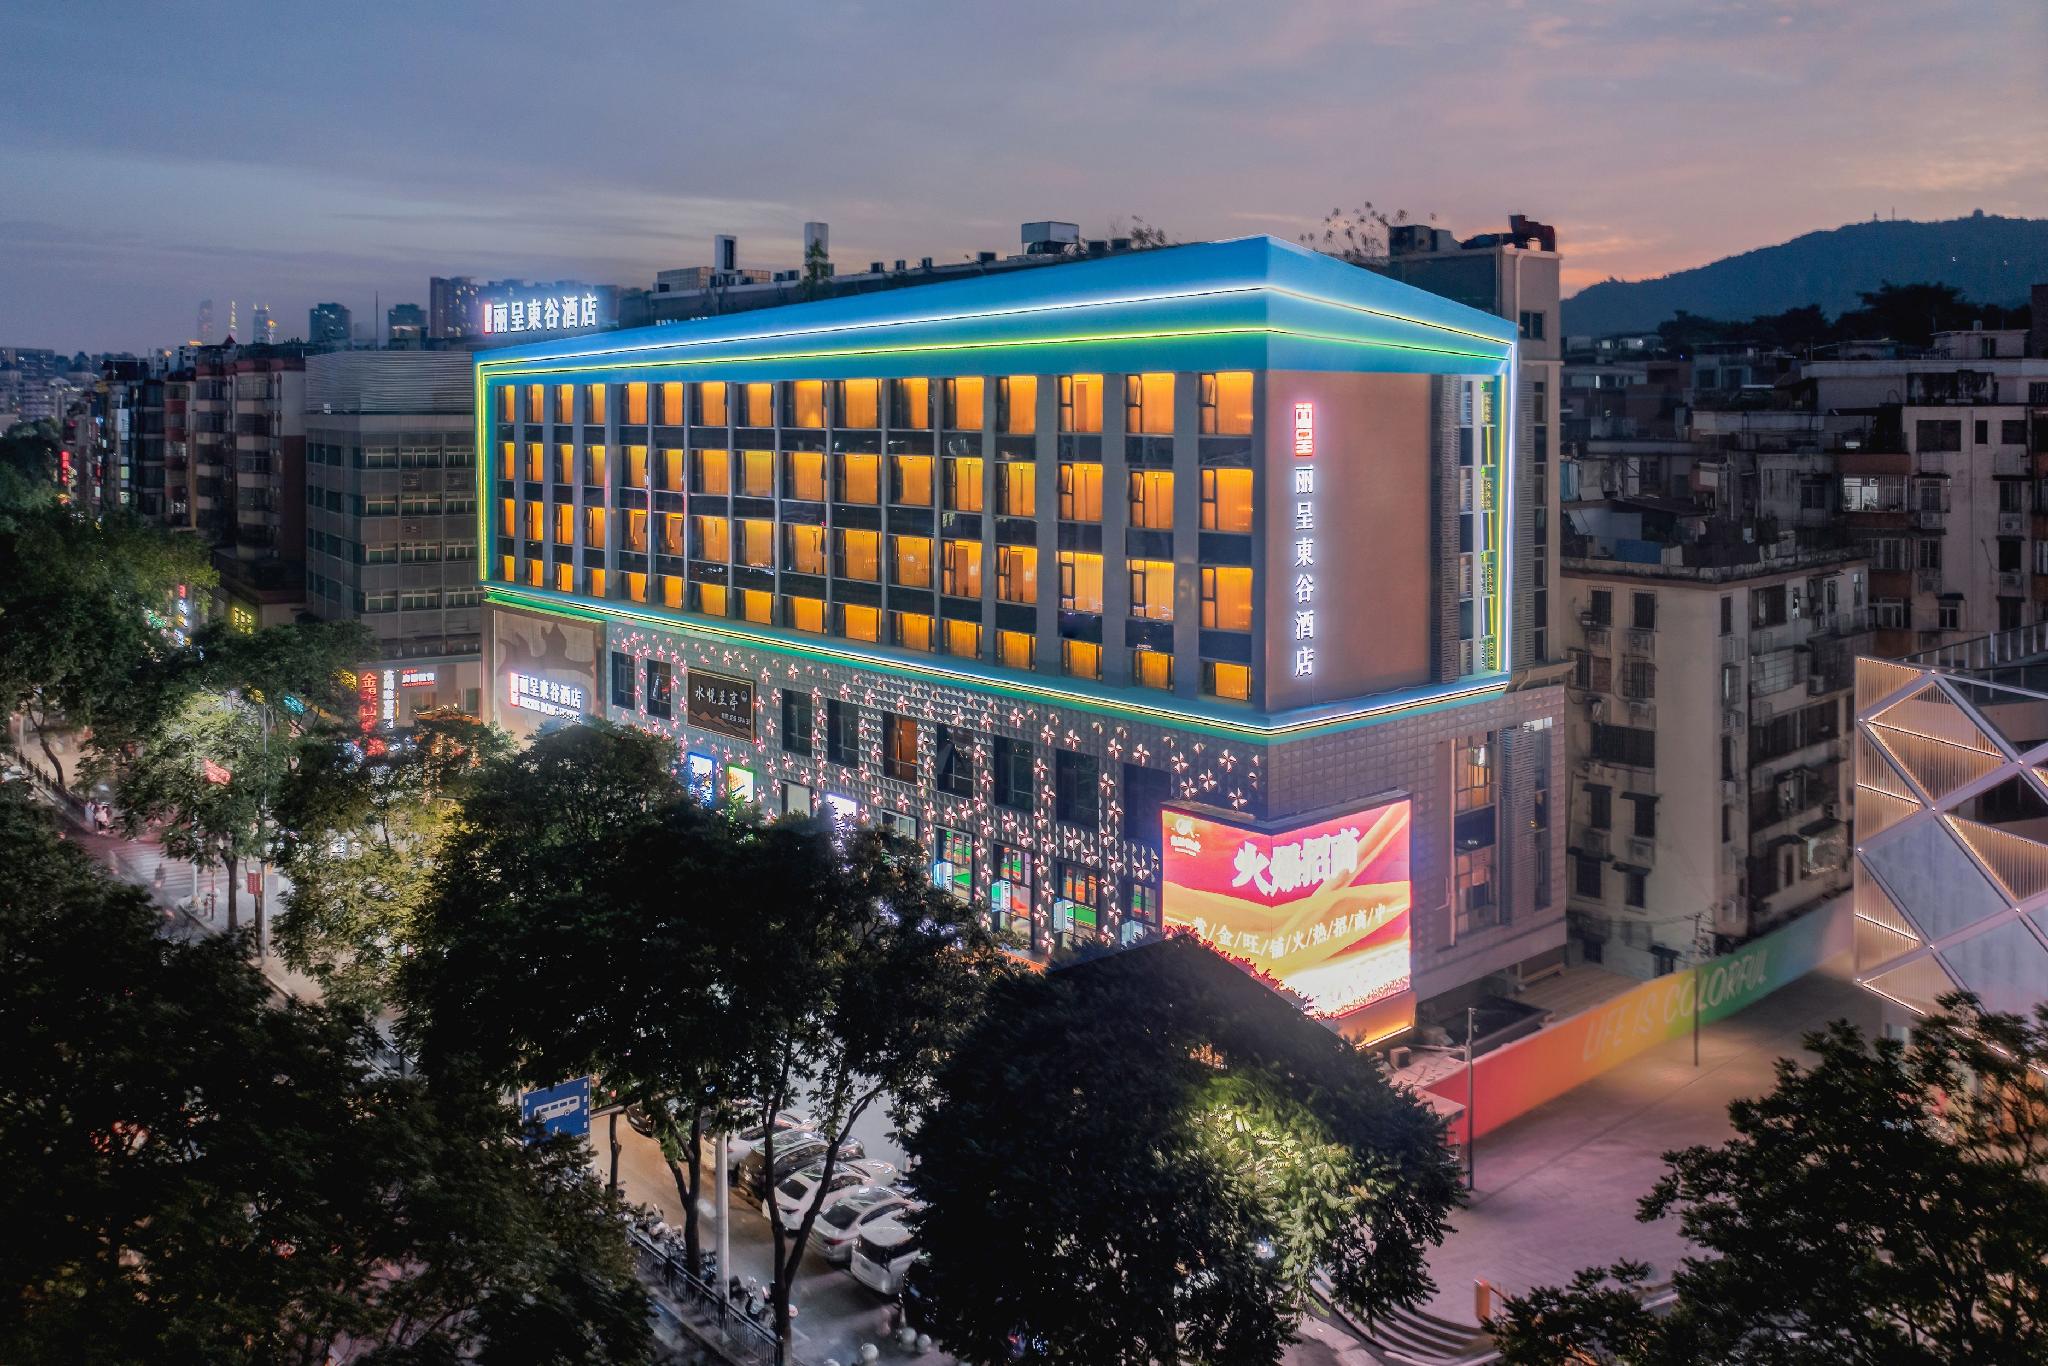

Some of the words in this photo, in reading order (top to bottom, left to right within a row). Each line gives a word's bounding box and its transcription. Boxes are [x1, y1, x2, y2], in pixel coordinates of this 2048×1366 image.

[493, 293, 598, 333] 丽呈東谷酒店
[1295, 465, 1314, 677] 丽呈東谷酒店
[1583, 1004, 1632, 1061] LIFE
[1632, 994, 1657, 1038] IS
[1663, 949, 1768, 1024] COLORFUL
